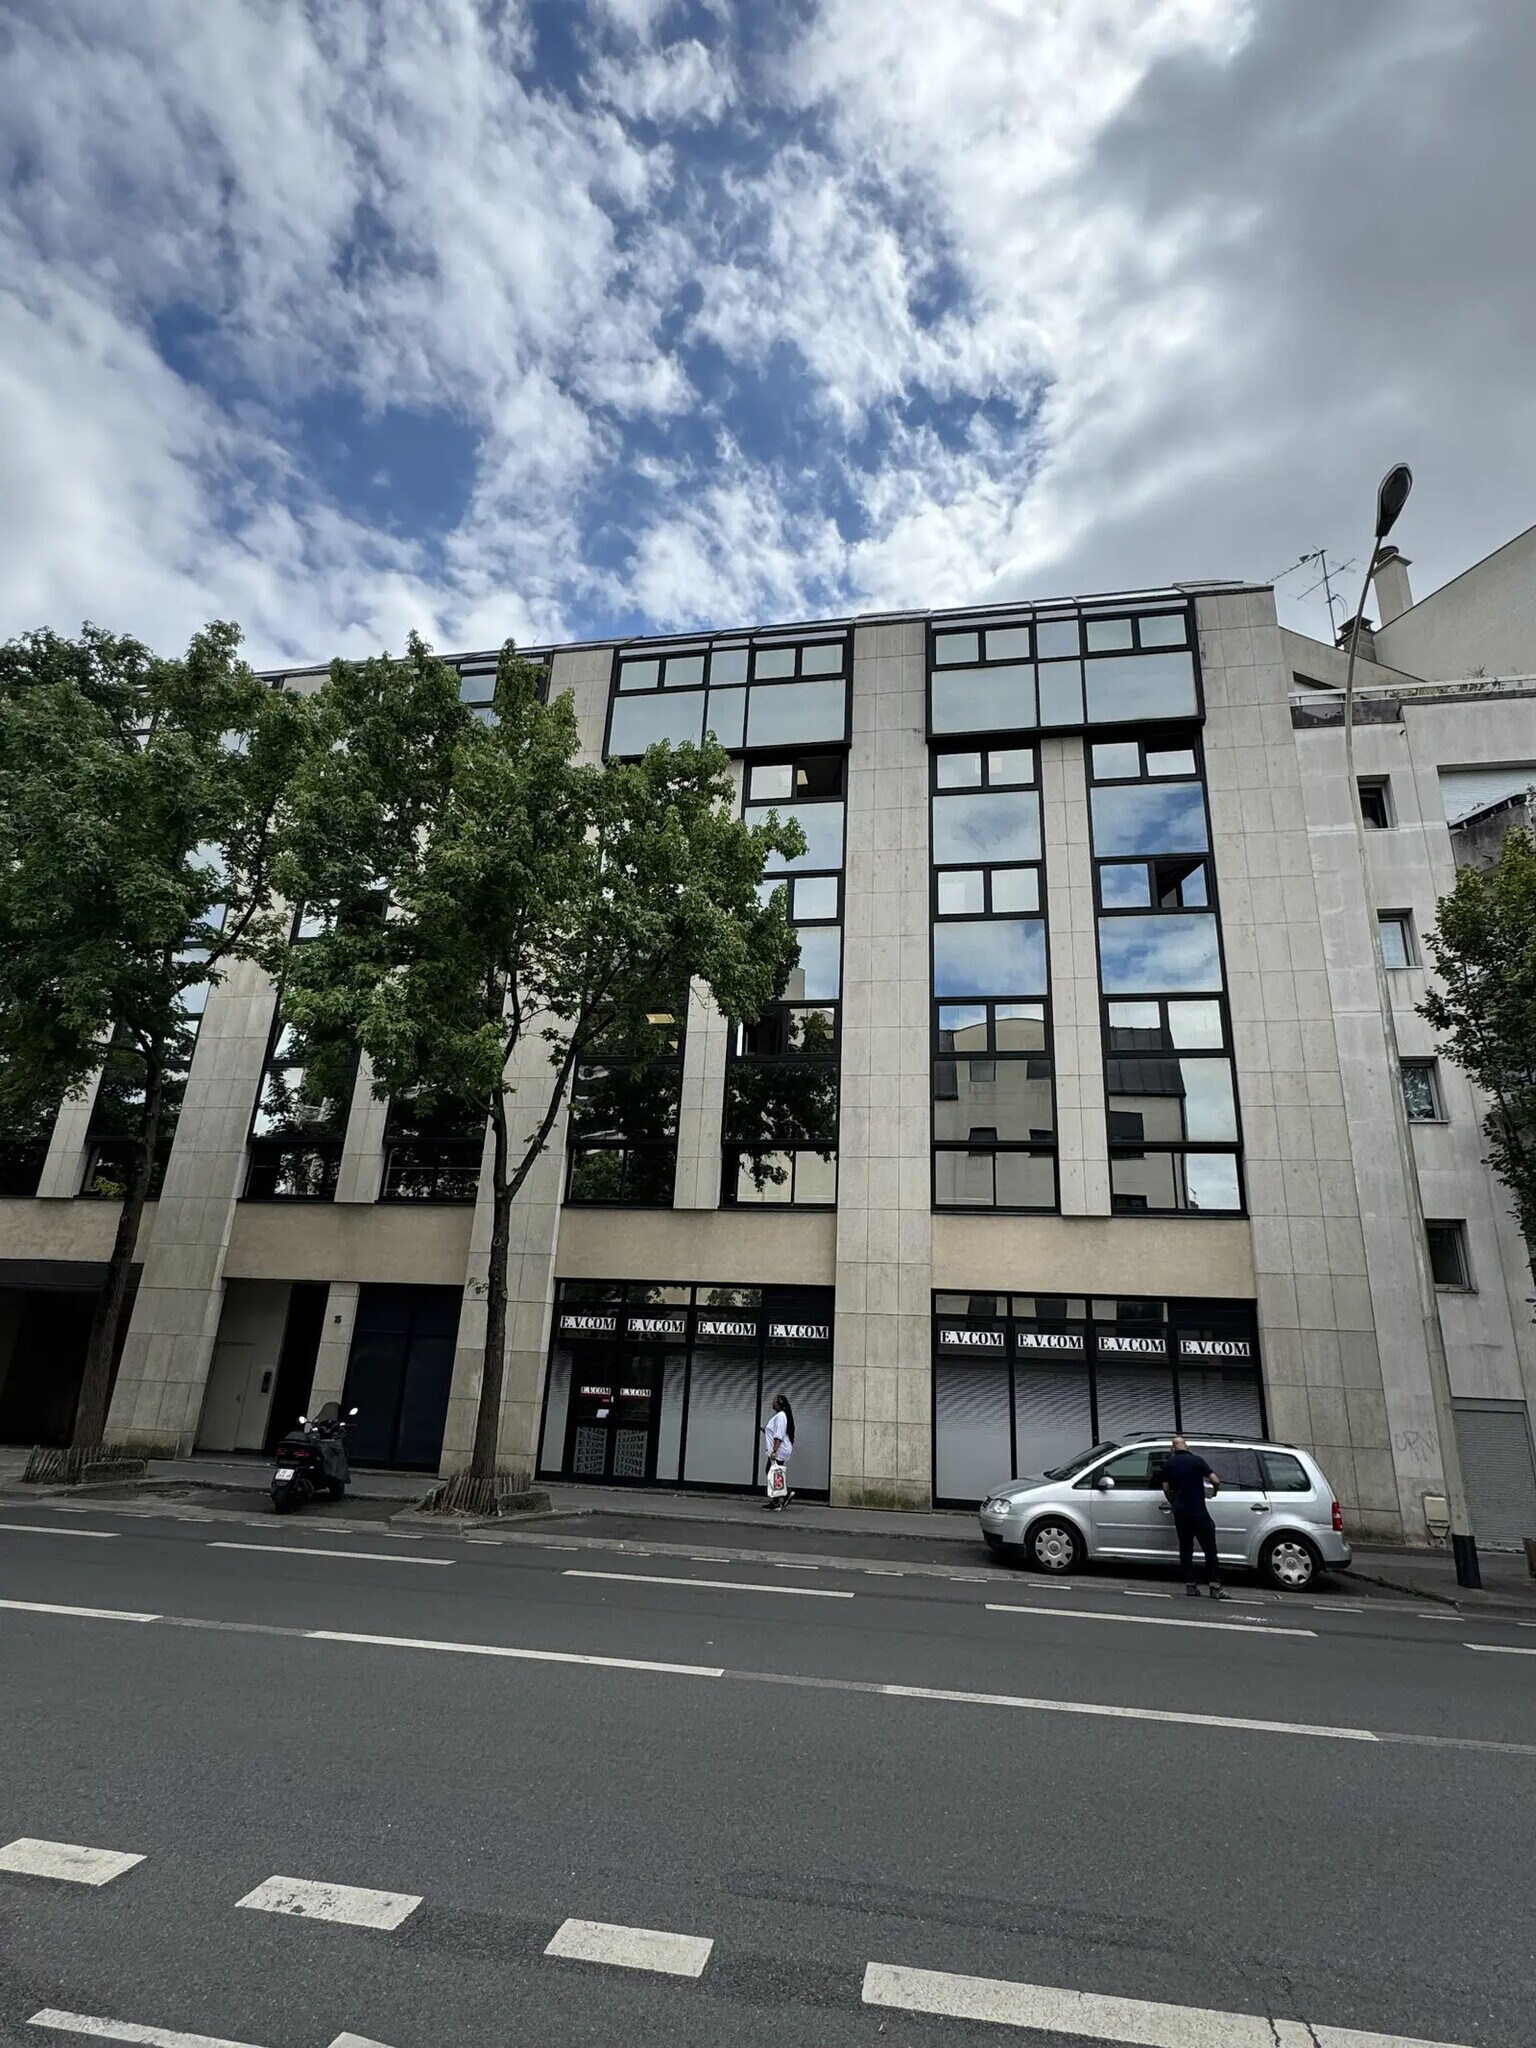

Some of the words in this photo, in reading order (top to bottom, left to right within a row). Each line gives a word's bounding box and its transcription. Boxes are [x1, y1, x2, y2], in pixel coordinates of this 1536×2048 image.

[561, 1317, 615, 1330] E.V.COM
[628, 1319, 684, 1332] E.V.COM
[698, 1322, 755, 1335] E.V.COM
[769, 1324, 828, 1338] E.V.COM
[941, 1331, 1003, 1346] E.V.COM
[1018, 1334, 1082, 1349] E.V.COM
[1099, 1337, 1165, 1353] E.V.COM
[1181, 1340, 1249, 1356] E.V.COM
